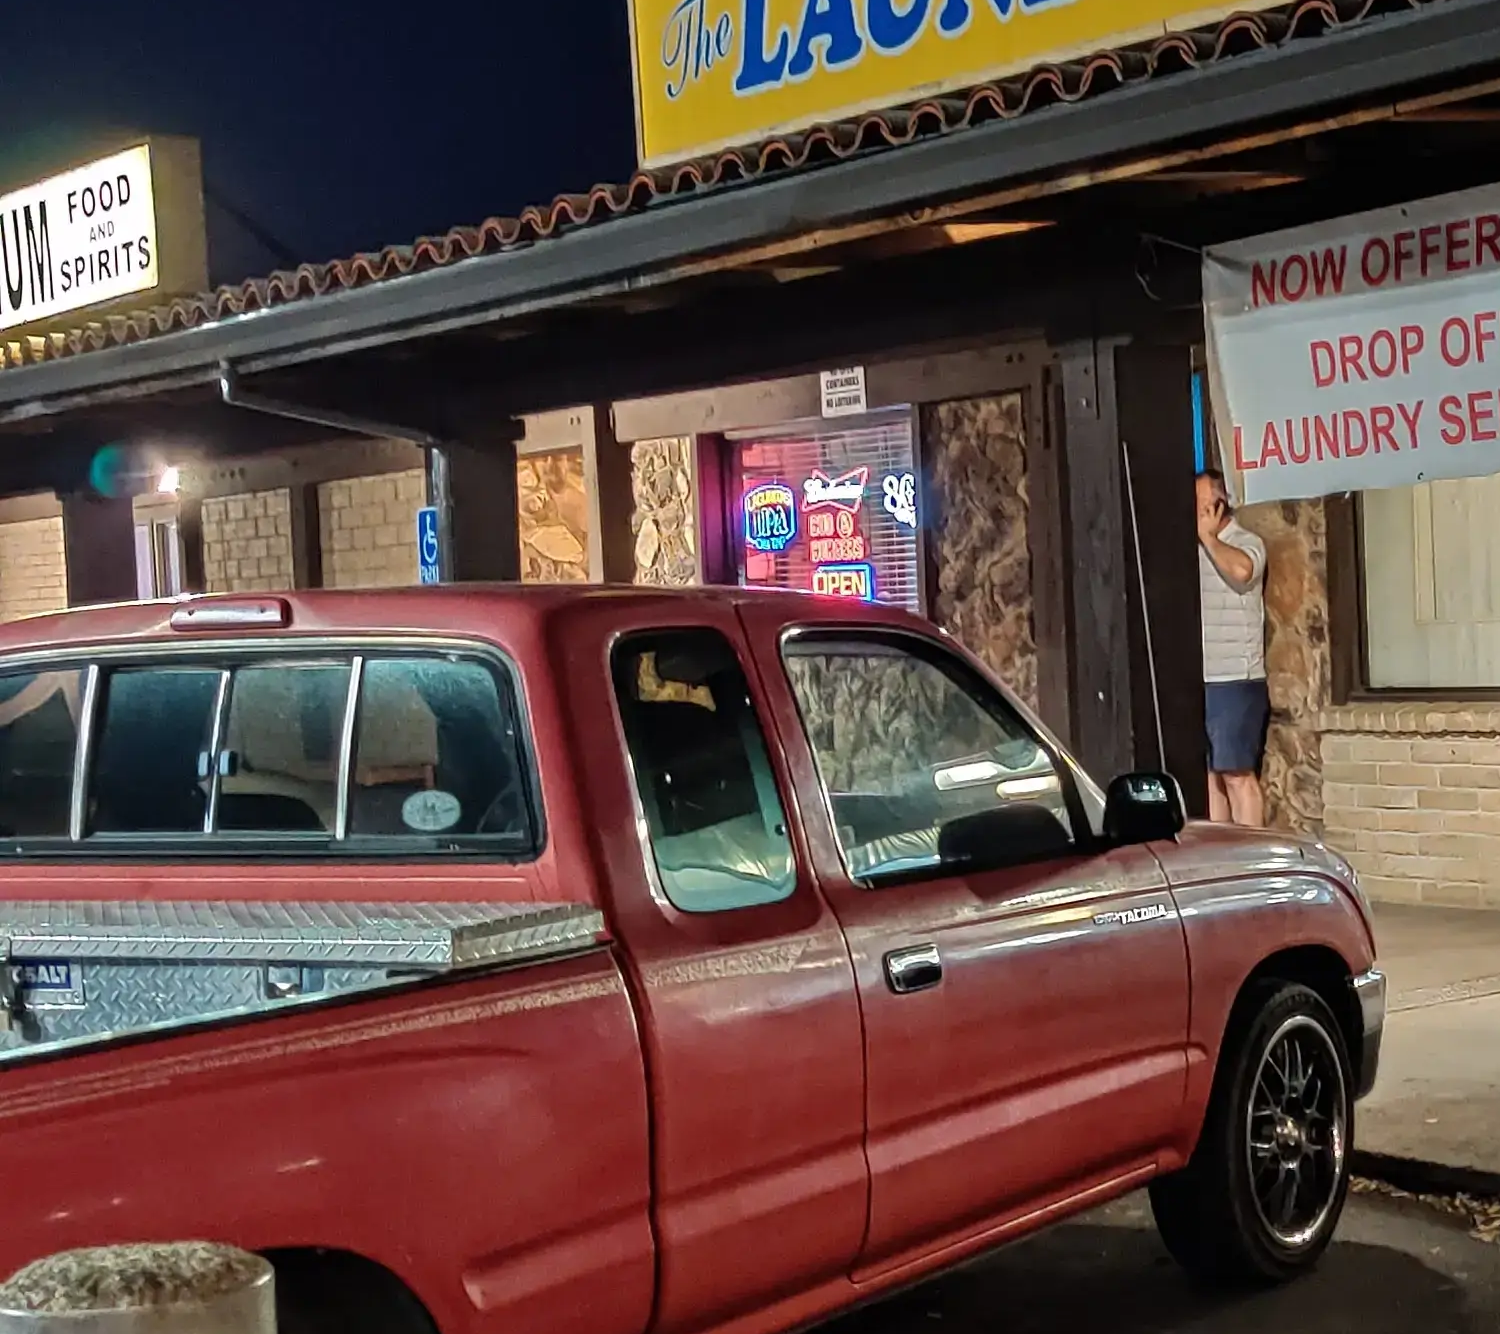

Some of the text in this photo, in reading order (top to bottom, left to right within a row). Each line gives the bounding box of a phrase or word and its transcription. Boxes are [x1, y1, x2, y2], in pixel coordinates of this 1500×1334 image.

[67, 174, 131, 224] FOOD
[0, 199, 55, 315] UM
[89, 220, 115, 243] AND
[60, 235, 151, 292] SPIRITS
[1251, 245, 1348, 308] NOW
[1309, 324, 1425, 388] DROP
[1233, 400, 1425, 470] LAUNDRY
[812, 570, 866, 597] OPEN
[1119, 904, 1168, 925] TACOMA
